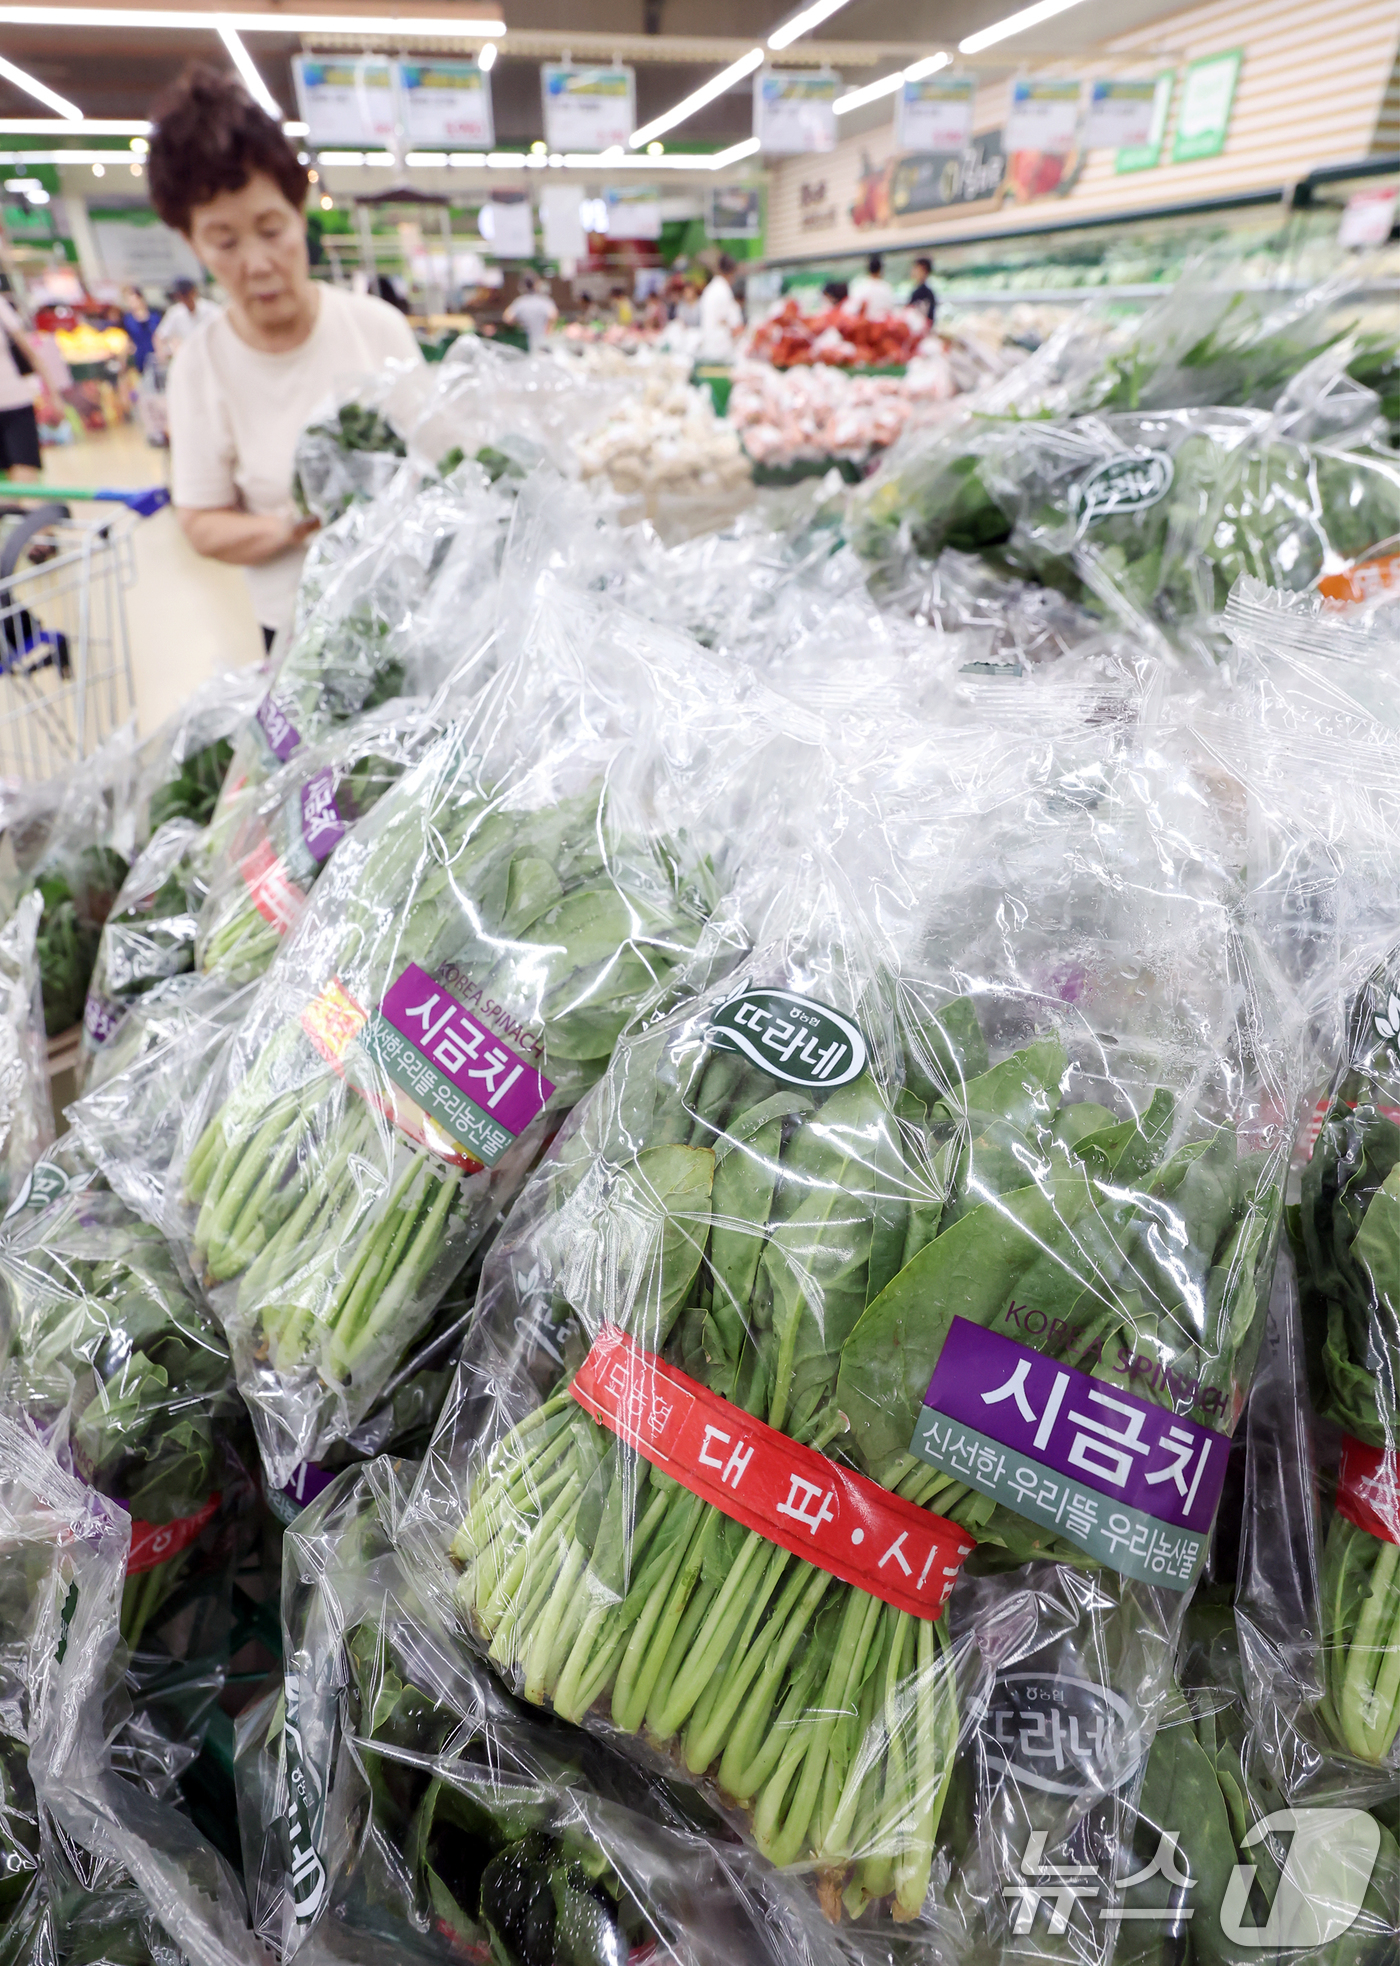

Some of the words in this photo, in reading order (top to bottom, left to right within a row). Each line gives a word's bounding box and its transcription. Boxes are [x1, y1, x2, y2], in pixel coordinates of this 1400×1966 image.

[405, 993, 525, 1109] 시금치
[438, 960, 484, 1005] KOREA
[480, 999, 545, 1059] SPINACH
[397, 1050, 438, 1096] 우리뜰
[432, 1085, 508, 1157] 우리농산물
[1004, 1300, 1104, 1365] KOREA
[1112, 1349, 1230, 1420] SPINACH
[980, 1358, 1213, 1516] 시금치
[922, 1421, 1006, 1489] 신선한
[1007, 1466, 1099, 1540] 우리뜰
[1100, 1512, 1200, 1579] 우리농산물
